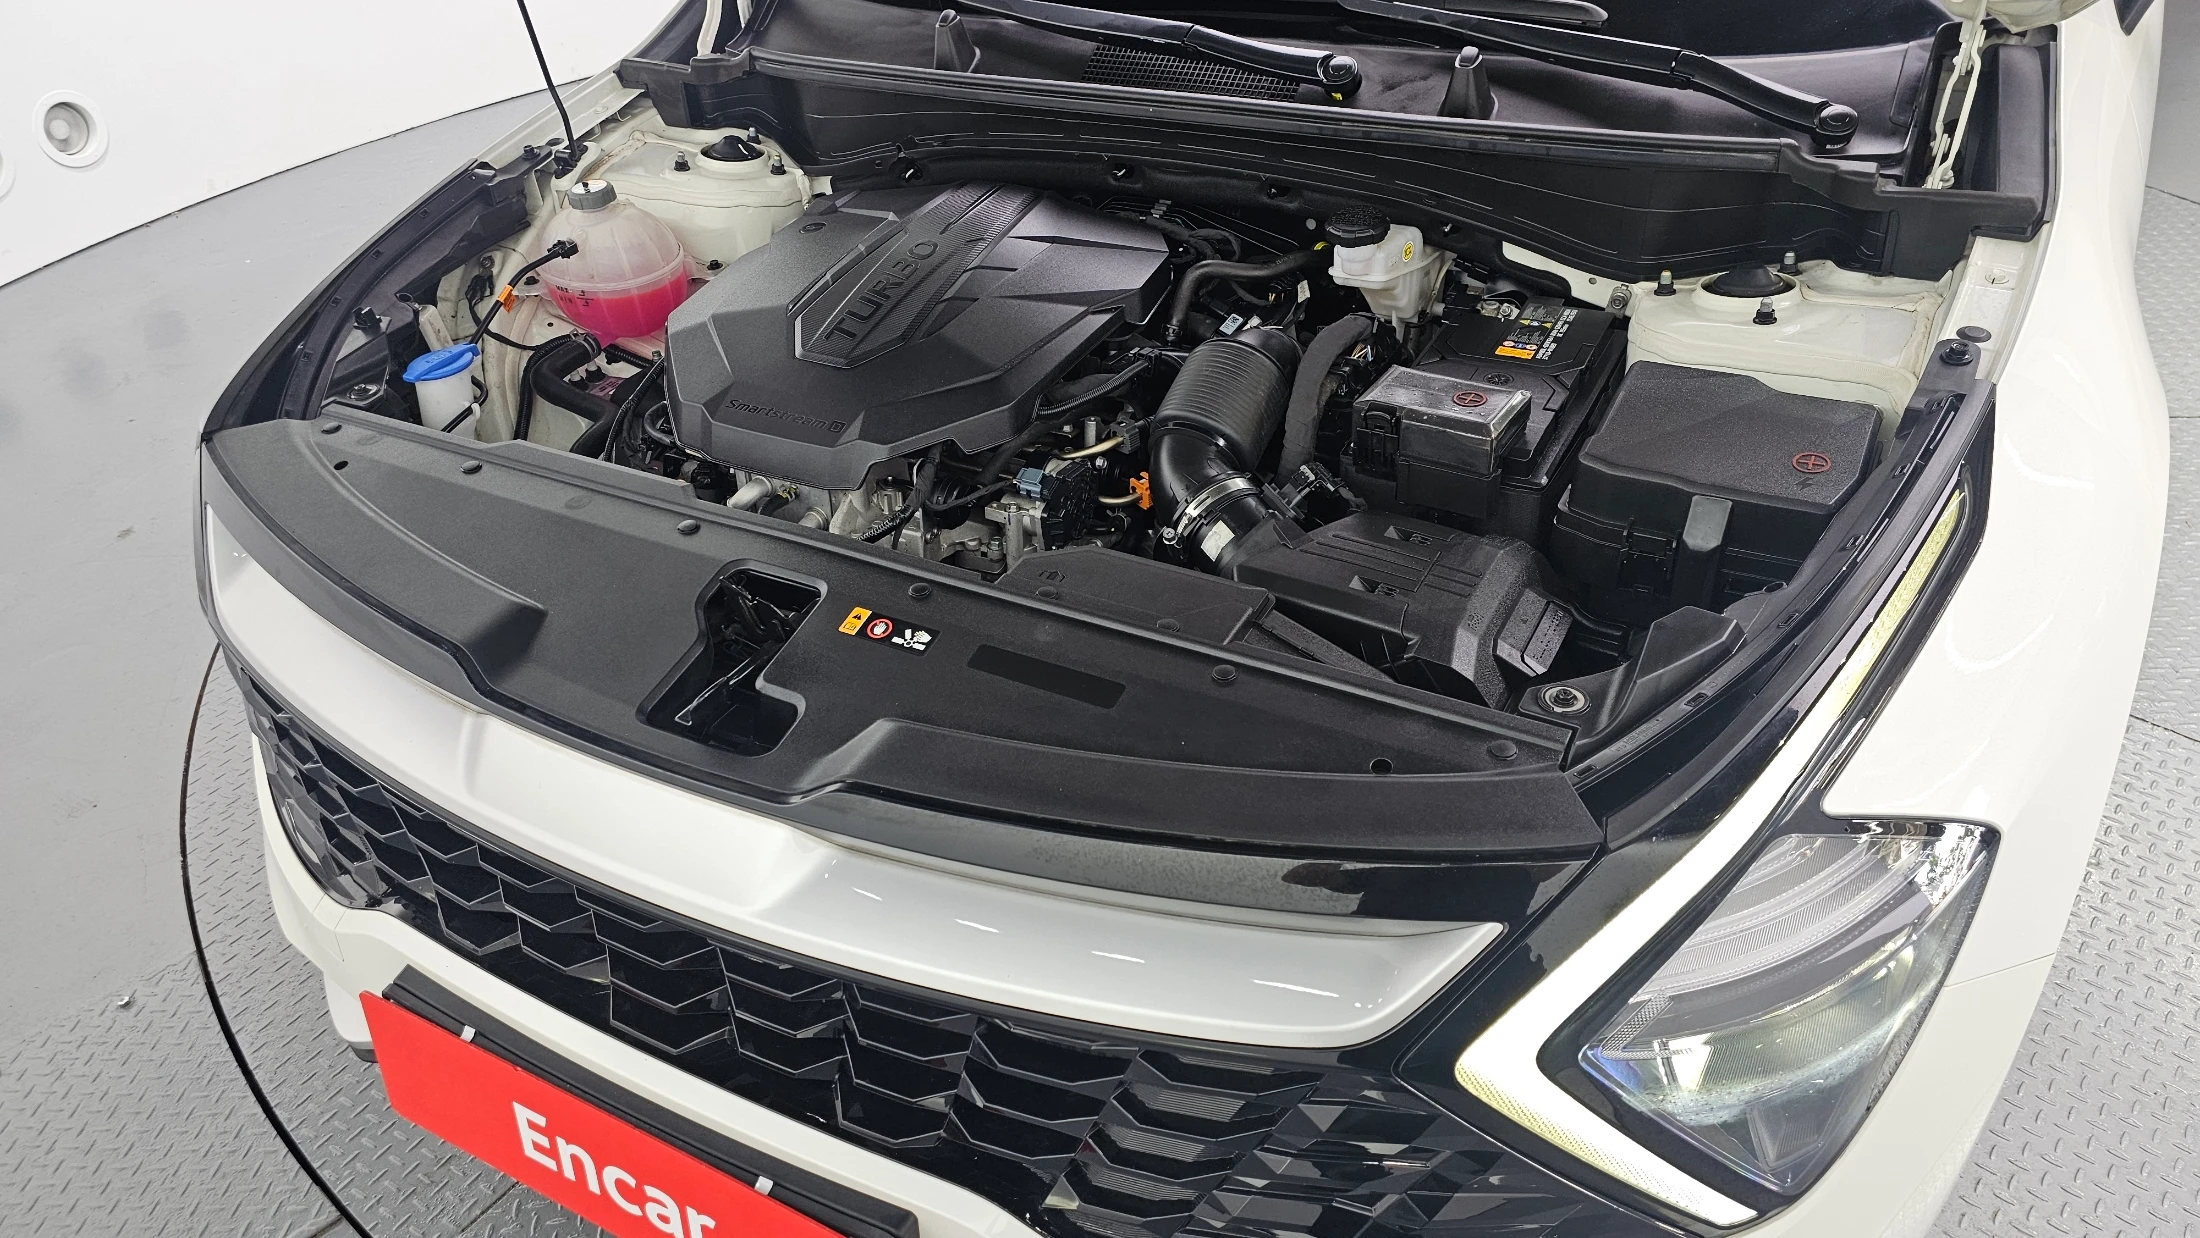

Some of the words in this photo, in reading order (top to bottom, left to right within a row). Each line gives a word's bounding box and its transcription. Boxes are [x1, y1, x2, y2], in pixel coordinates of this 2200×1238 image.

[823, 240, 939, 340] TURBO
[725, 399, 828, 429] Smartstream
[512, 1101, 717, 1238] Encar
